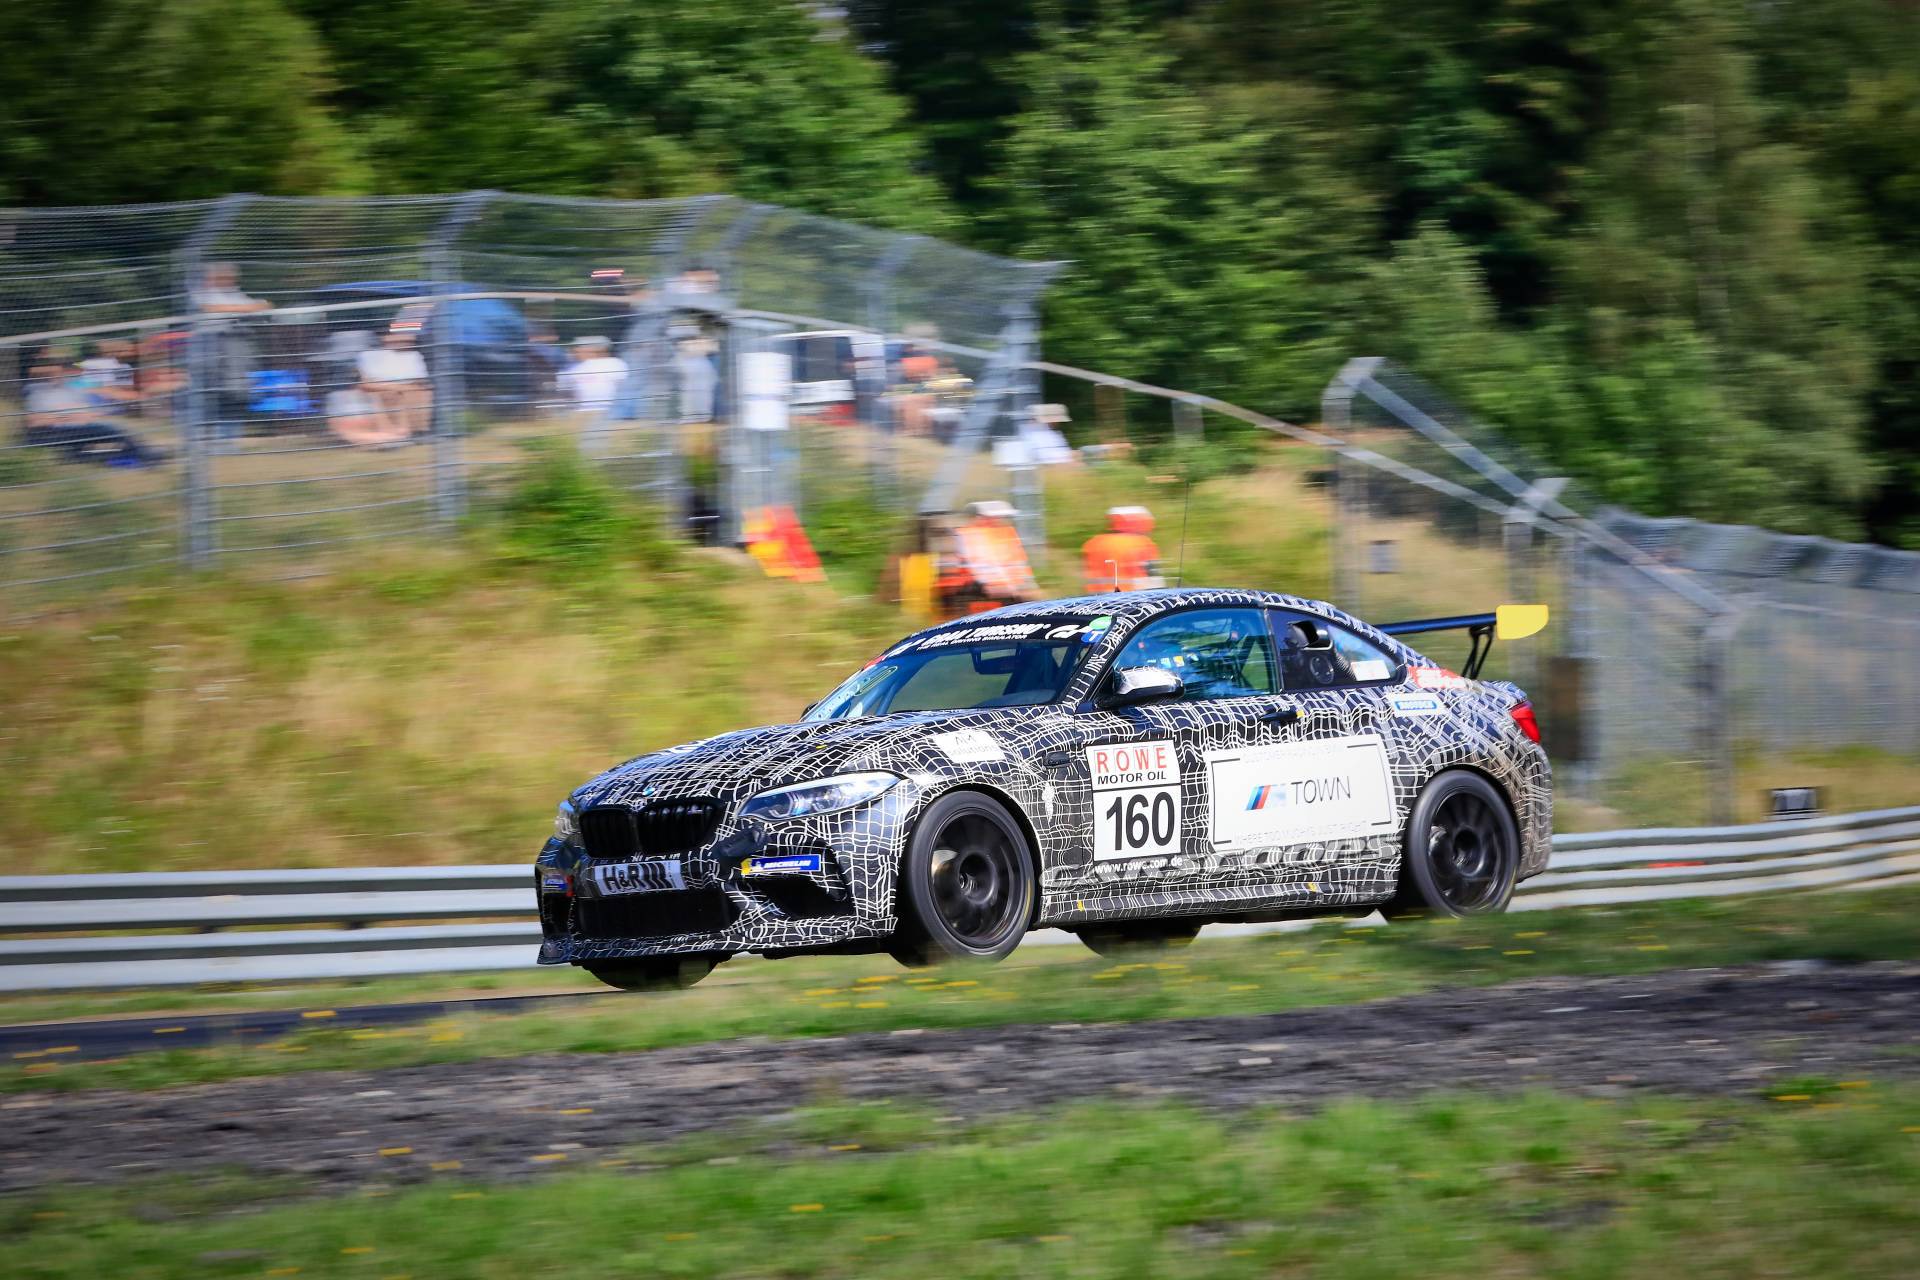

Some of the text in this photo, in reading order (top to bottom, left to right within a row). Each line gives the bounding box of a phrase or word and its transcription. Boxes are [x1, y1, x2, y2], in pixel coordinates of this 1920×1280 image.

[1096, 747, 1168, 774] ROWE
[1097, 770, 1167, 785] MOTOR OIL
[1290, 776, 1352, 805] TOWN
[1106, 791, 1175, 851] 160
[602, 864, 647, 891] H&R
